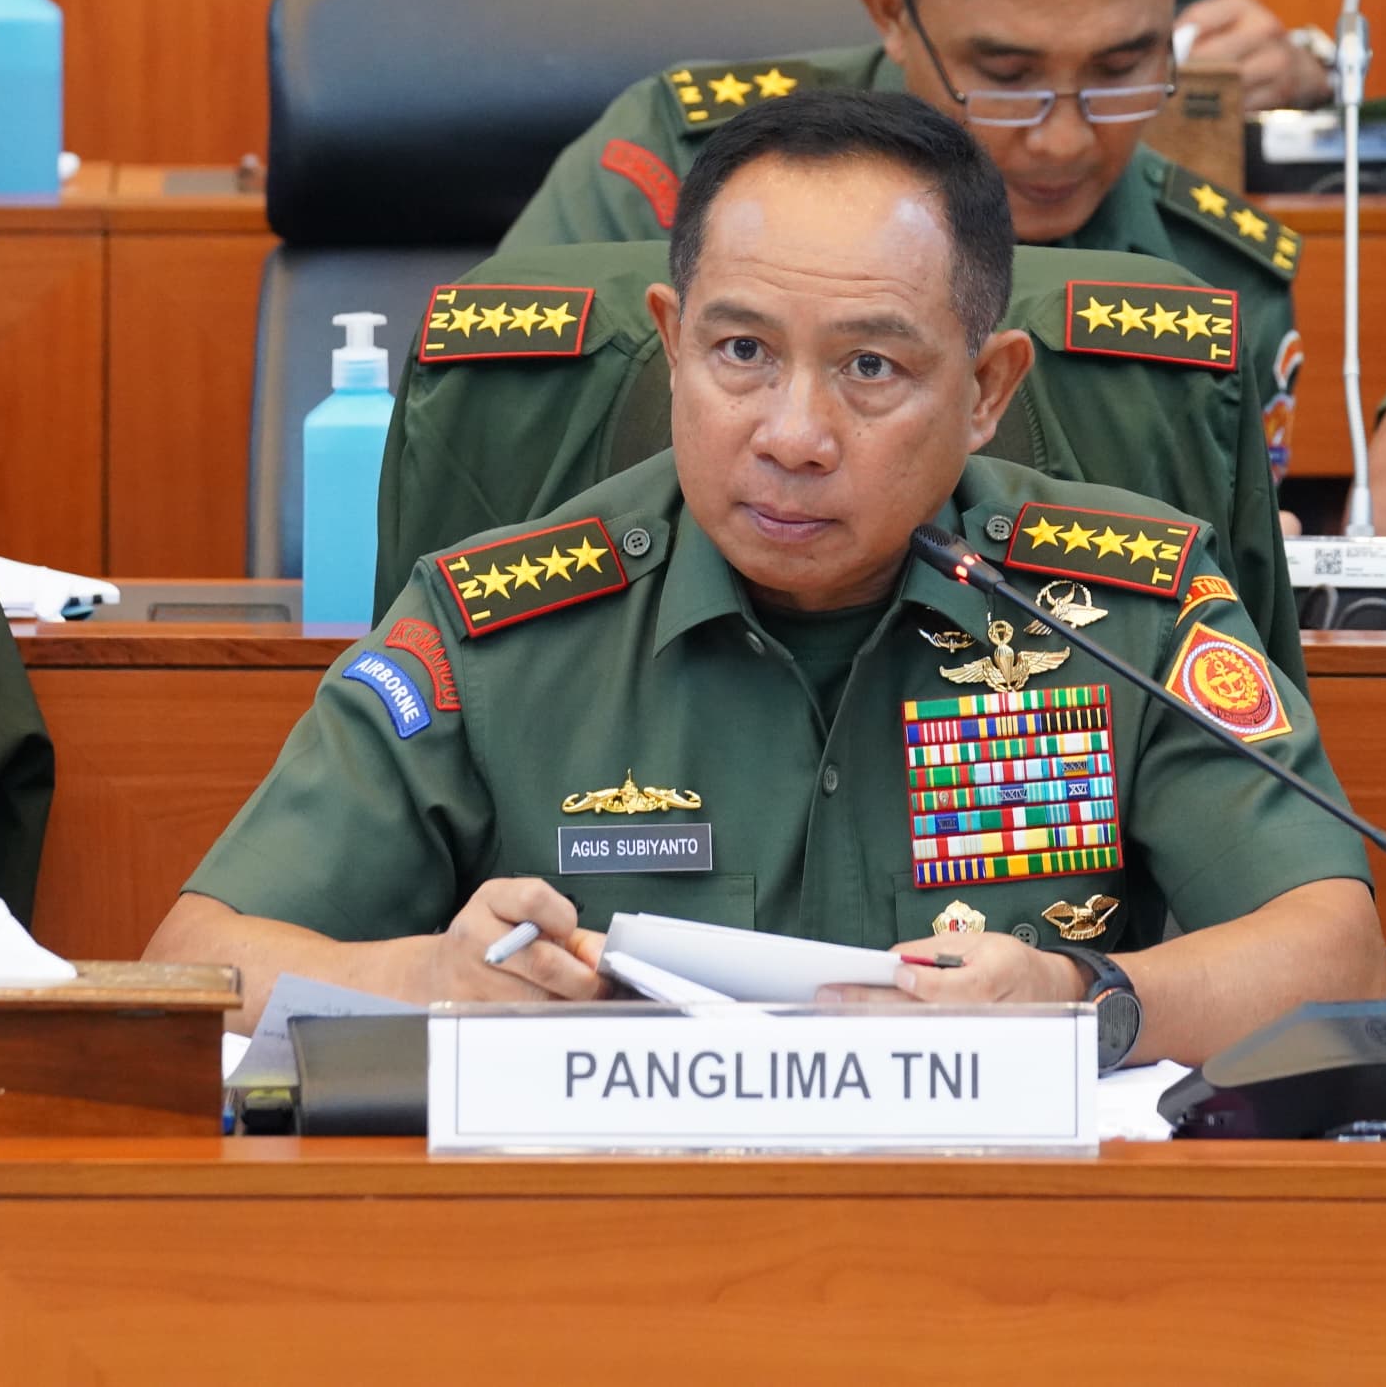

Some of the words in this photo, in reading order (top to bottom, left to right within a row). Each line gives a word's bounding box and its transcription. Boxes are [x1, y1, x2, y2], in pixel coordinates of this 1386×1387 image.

[671, 70, 709, 121] TNI
[425, 290, 458, 350] TNI
[1210, 297, 1233, 360] TNI
[1151, 527, 1189, 585] TNI
[449, 556, 491, 621] TNI
[1192, 579, 1227, 594] TNI
[355, 657, 420, 724] AIRBORNE
[1068, 783, 1089, 796] XVI
[571, 839, 610, 858] AGUS
[616, 837, 699, 857] SUBIYANTO
[565, 1050, 872, 1100] PANGLIMA
[891, 1051, 980, 1100] TNI
